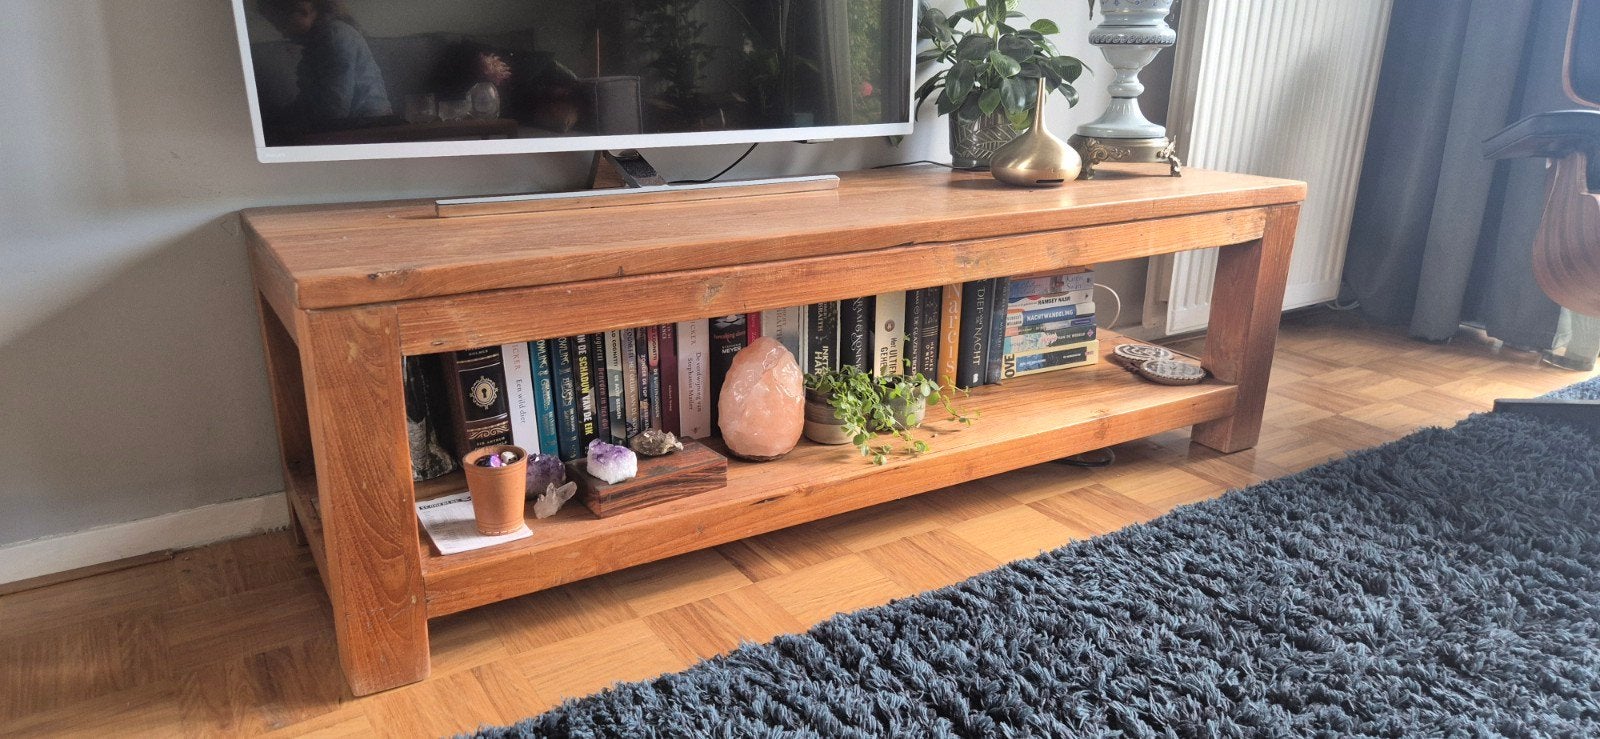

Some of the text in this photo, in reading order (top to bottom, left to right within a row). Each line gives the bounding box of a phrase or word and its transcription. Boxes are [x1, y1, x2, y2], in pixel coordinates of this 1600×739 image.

[976, 287, 986, 313] DIEF
[1037, 298, 1057, 306] RAMSEY
[913, 316, 920, 325] DE
[1026, 309, 1074, 322] NACHTWANDELING
[855, 324, 863, 333] &
[946, 283, 961, 374] Narcis
[626, 330, 634, 359] OGNETTI
[890, 337, 898, 348] Het
[911, 326, 919, 355] GLAZEN
[973, 324, 983, 366] NACHT
[511, 344, 520, 370] ICKER
[536, 340, 547, 368] OWLING
[558, 337, 569, 365] OWLING
[696, 352, 703, 361] De
[851, 332, 863, 370] KONINK
[880, 347, 888, 366] GEHE
[628, 360, 636, 372] HET
[640, 354, 648, 376] ZONDER
[653, 368, 659, 376] DE
[814, 351, 822, 375] HAR
[1004, 353, 1015, 378] OVE
[577, 334, 594, 435] IN DE SCHADUW VAN DE EIK
[598, 367, 607, 396] Beneden
[614, 374, 620, 382] DE
[695, 362, 703, 400] verdwijning
[517, 394, 525, 408] wild
[630, 394, 638, 406] VAN
[519, 410, 527, 424] dier
[601, 406, 609, 417] het
[631, 407, 639, 416] DE
